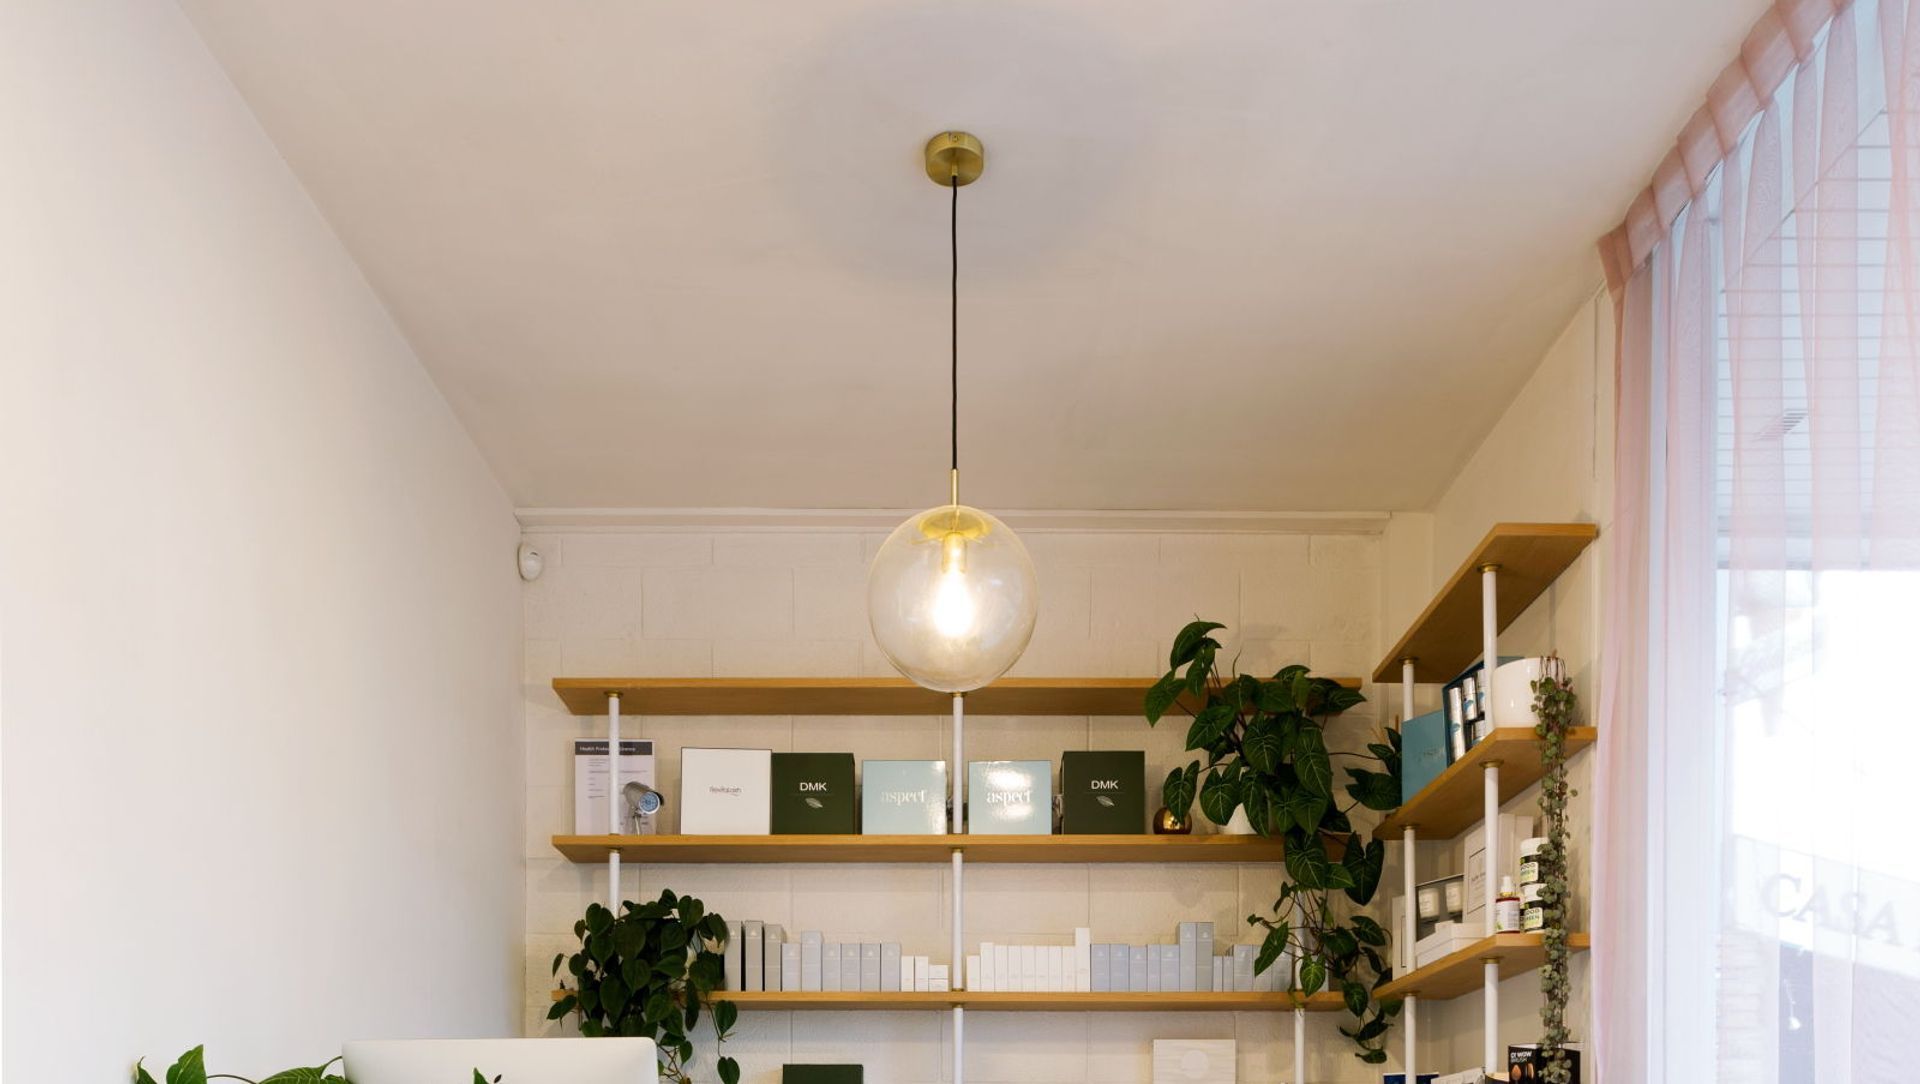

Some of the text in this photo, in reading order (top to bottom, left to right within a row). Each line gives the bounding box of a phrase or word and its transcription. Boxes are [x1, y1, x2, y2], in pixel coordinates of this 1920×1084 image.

[800, 781, 827, 792] DMK
[1090, 780, 1119, 790] DMK
[880, 789, 927, 806] aspect
[986, 789, 1032, 806] aspect
